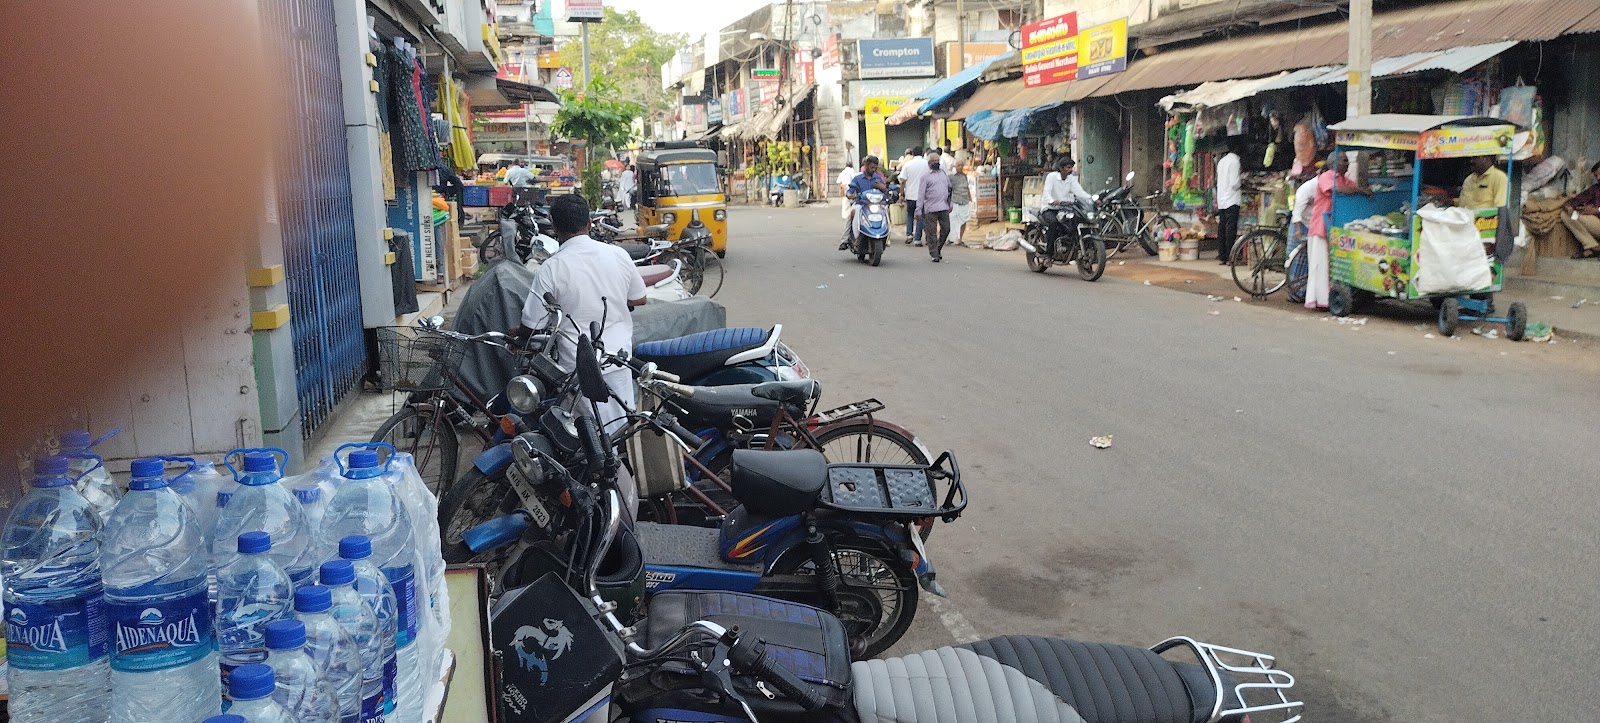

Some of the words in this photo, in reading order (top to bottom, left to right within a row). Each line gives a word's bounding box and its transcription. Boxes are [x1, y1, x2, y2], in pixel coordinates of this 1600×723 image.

[872, 48, 920, 58] Crompton
[1038, 59, 1055, 71] General
[1054, 55, 1077, 68] Merchant
[1438, 135, 1457, 145] S.M
[422, 215, 432, 233] SILKS
[424, 234, 433, 258] NELLAI
[731, 408, 757, 416] YAMAHA
[520, 490, 531, 502] AK
[532, 504, 546, 523] 2823
[116, 613, 200, 655] AIDENAQUA
[505, 684, 526, 710] HONDA
